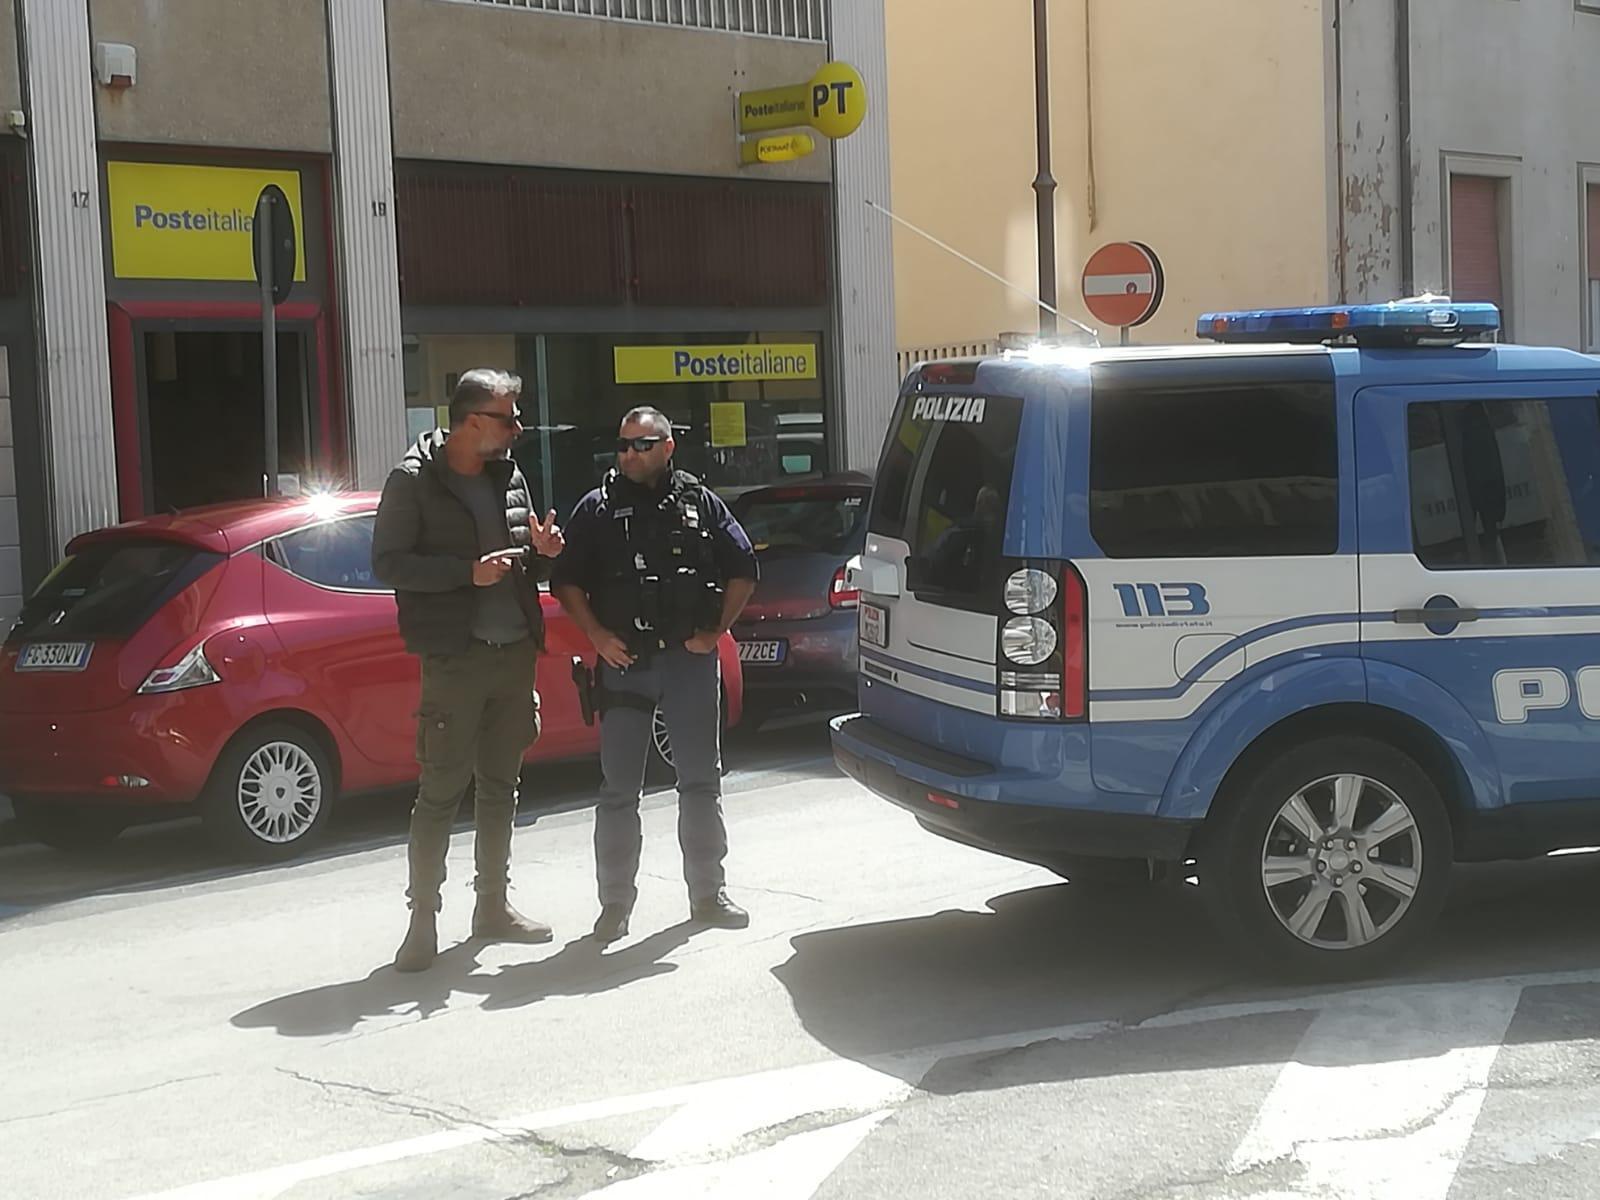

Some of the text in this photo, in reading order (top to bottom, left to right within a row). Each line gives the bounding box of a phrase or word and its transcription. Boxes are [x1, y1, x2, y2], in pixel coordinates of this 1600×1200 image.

[812, 81, 853, 118] PT
[135, 204, 254, 233] Posteitalia
[674, 348, 807, 376] Posteitaliane
[911, 397, 986, 423] POLIZIA
[1112, 582, 1211, 617] 113
[738, 642, 777, 660] 772CE
